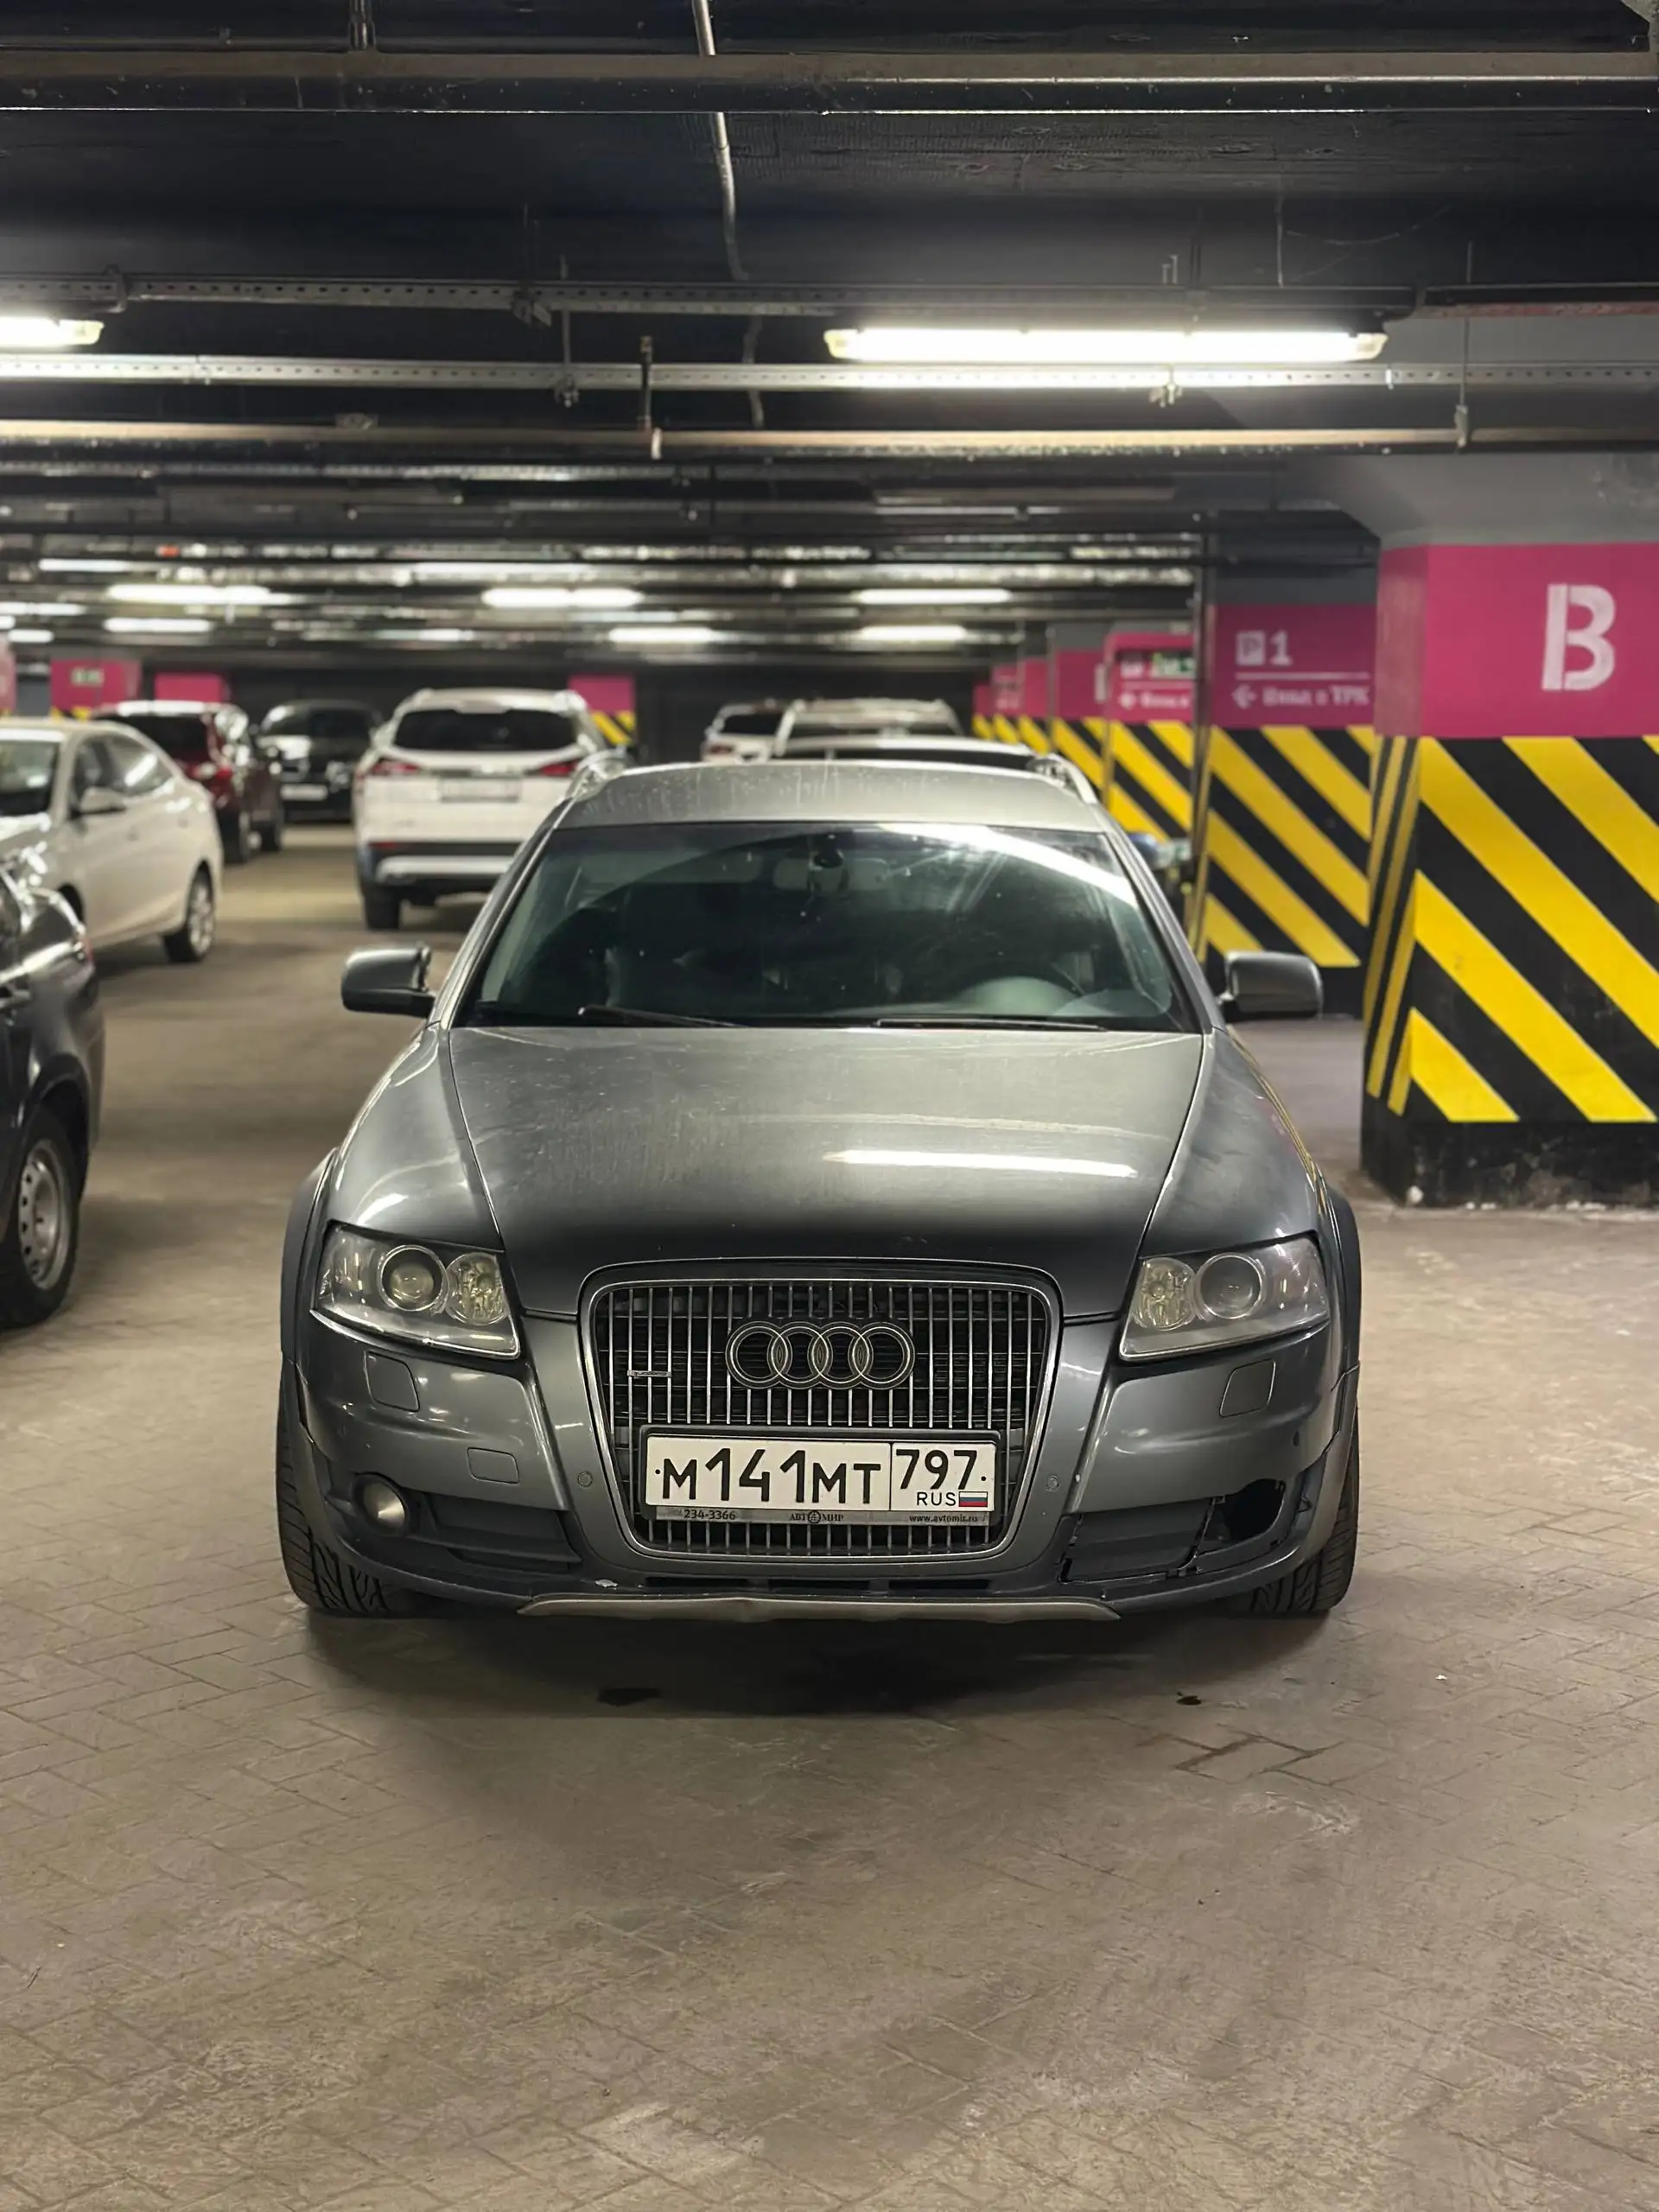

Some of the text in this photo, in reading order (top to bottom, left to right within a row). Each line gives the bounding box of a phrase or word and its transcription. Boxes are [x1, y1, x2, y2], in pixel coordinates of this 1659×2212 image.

[1269, 629, 1293, 665] 1
[1541, 582, 1616, 691] B
[895, 1449, 978, 1490] 797
[916, 1491, 957, 1507] RUS
[683, 1509, 736, 1521] 234-3366
[909, 1513, 978, 1524] www.avtomir.ru
